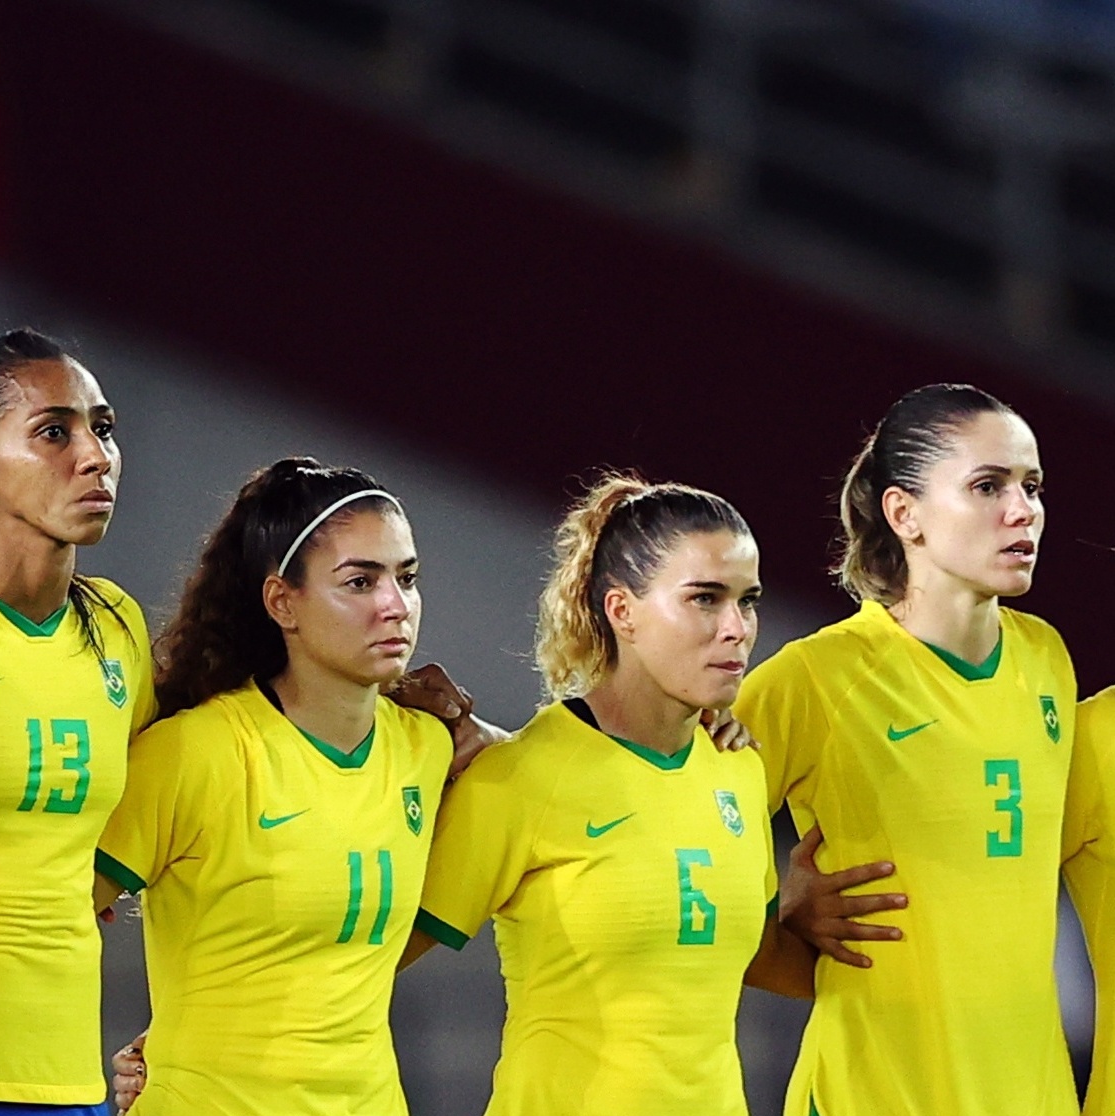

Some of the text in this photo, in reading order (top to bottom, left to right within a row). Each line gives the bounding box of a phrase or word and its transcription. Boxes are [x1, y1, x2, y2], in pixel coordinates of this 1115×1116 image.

[18, 718, 92, 815] 13
[984, 758, 1024, 858] 3
[338, 849, 394, 946] 11
[676, 848, 718, 946] 6
